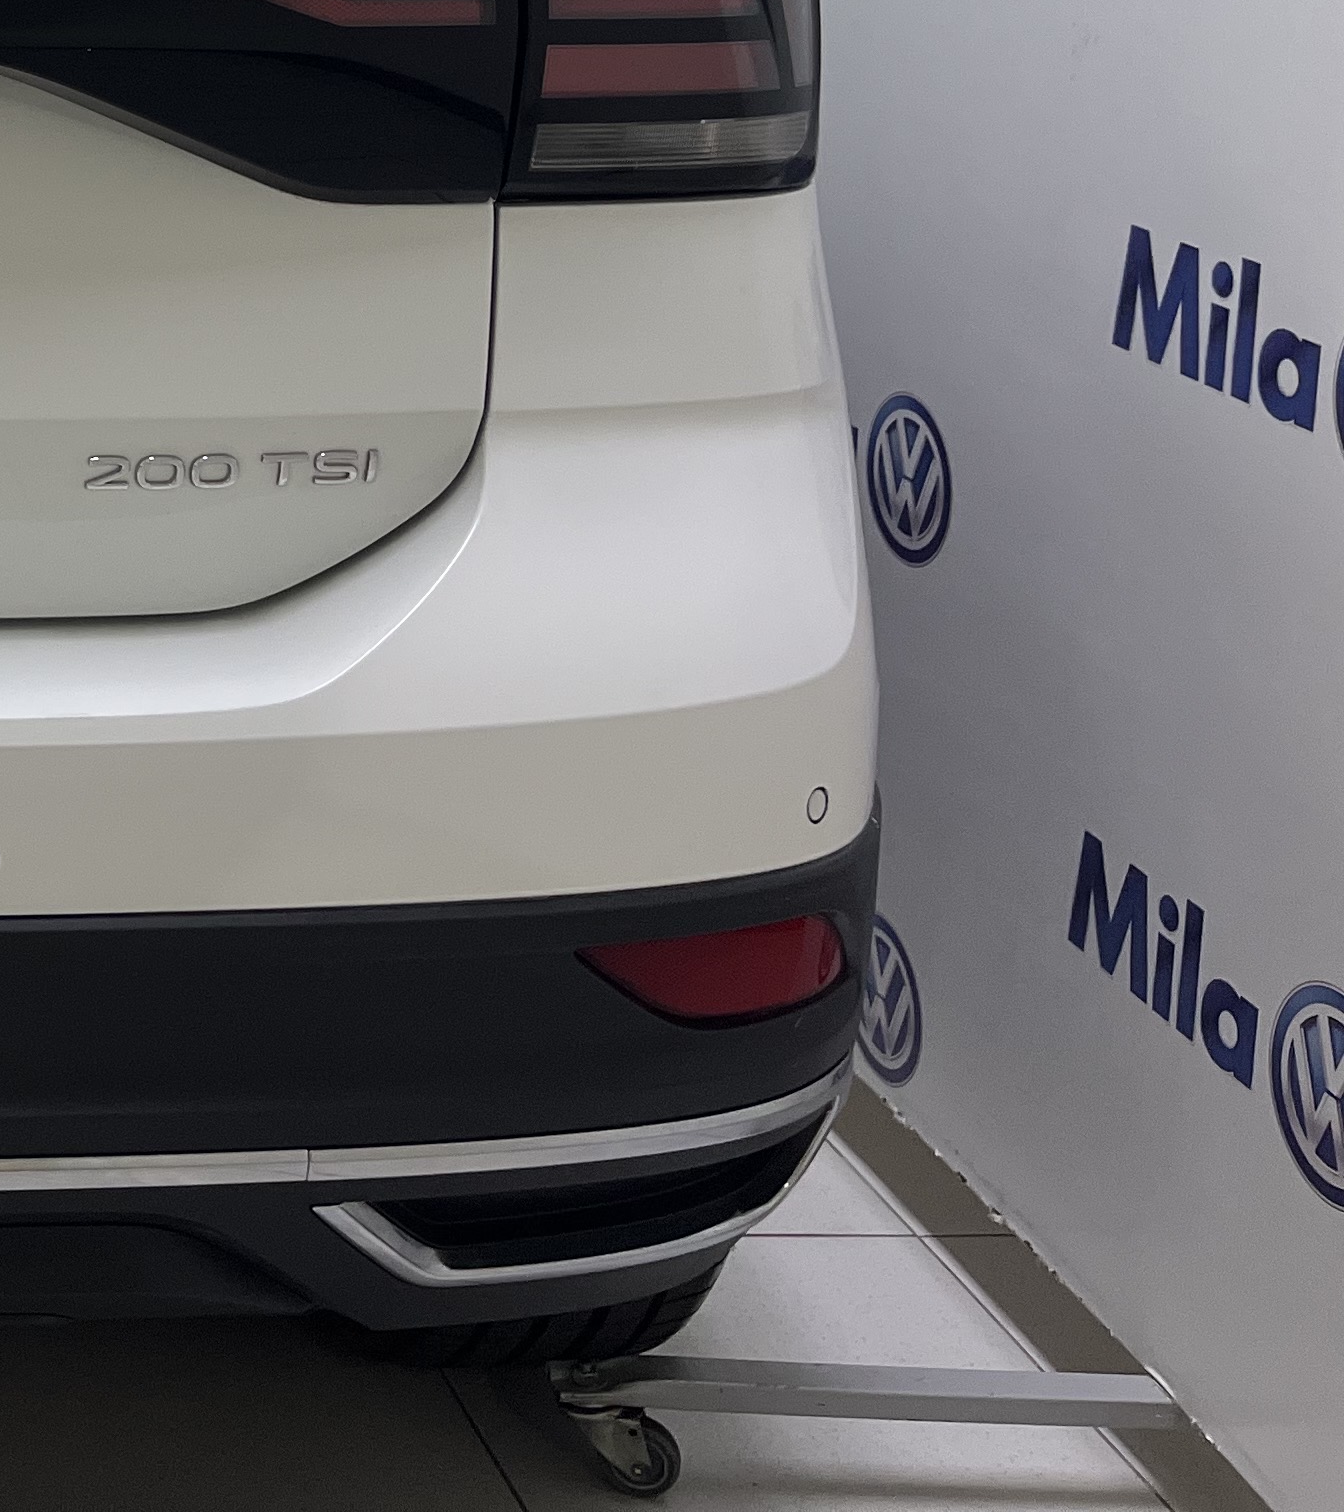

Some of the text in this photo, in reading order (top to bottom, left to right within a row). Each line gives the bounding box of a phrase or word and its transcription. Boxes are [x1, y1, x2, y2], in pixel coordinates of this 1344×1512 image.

[1112, 224, 1321, 432] Mila
[84, 448, 379, 489] 200 TSI
[868, 393, 952, 566] VW
[1068, 830, 1259, 1090] Mila
